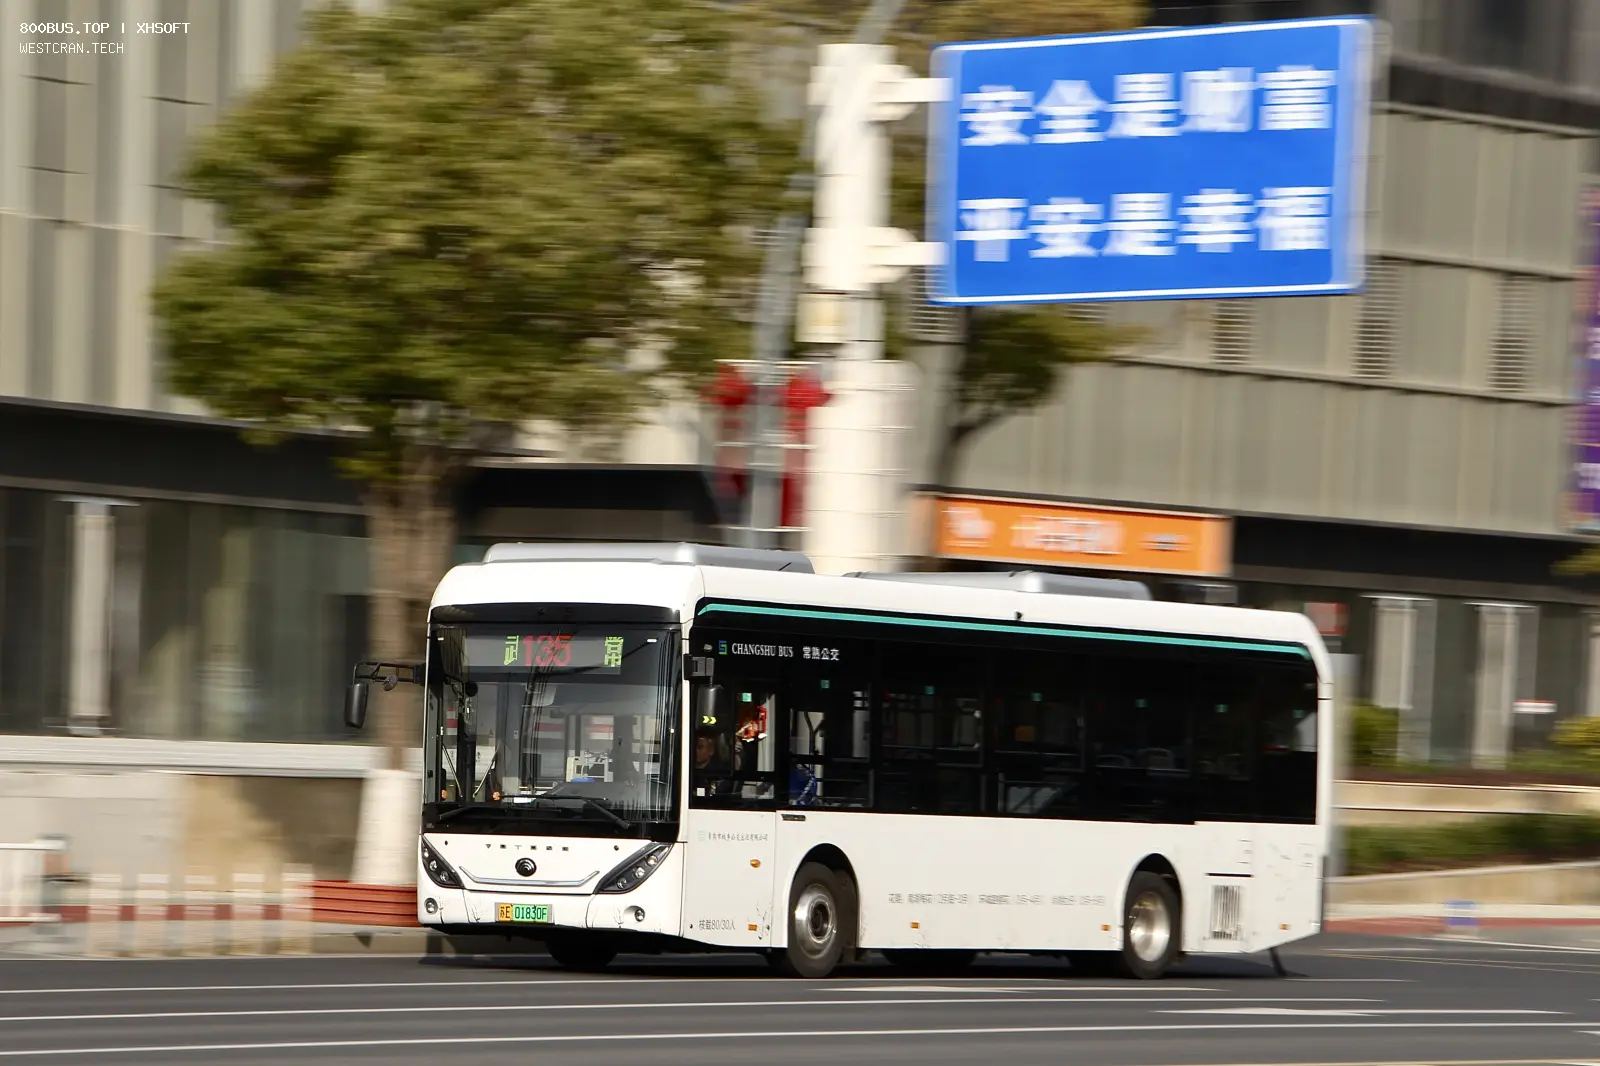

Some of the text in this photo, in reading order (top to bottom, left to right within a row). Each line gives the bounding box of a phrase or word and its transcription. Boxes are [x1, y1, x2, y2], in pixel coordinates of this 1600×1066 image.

[954, 187, 1331, 262] 平安是幸福
[522, 635, 573, 667] 135
[731, 643, 840, 661] CHANGSHU BUS 常熟公交
